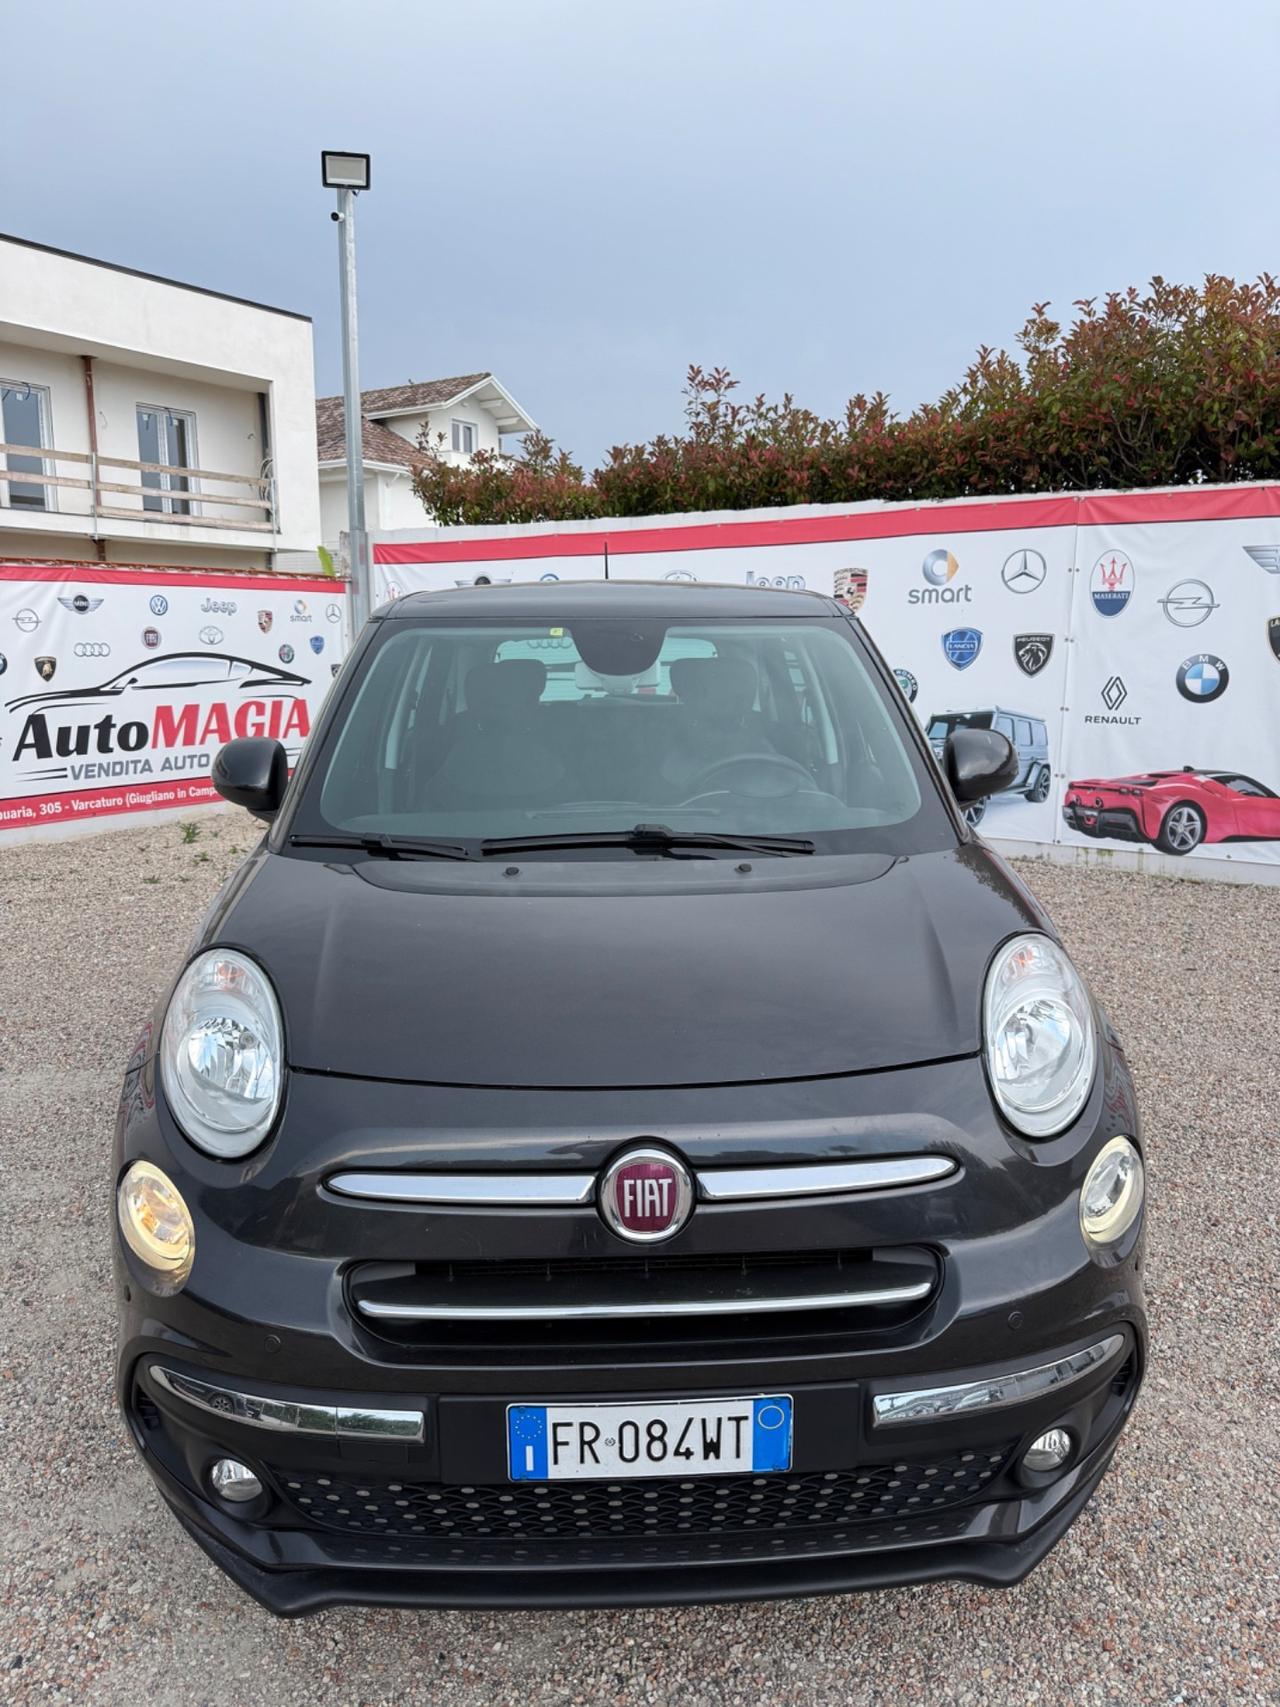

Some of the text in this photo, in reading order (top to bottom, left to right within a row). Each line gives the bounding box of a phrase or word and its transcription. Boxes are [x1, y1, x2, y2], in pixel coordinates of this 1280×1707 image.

[907, 584, 972, 604] smart
[1093, 592, 1129, 600] MASERATI
[200, 597, 238, 616] Jeep
[289, 614, 313, 623] smart
[1182, 655, 1226, 671] BMW
[12, 698, 311, 762] AutoMAGIA
[1084, 715, 1142, 726] RENAULT
[70, 753, 210, 781] VENDITA AUTO
[39, 802, 62, 815] 305
[71, 796, 123, 811] Varcaturo
[125, 788, 175, 807] (Giugliano
[177, 788, 187, 798] in
[623, 1178, 673, 1217] FIAT
